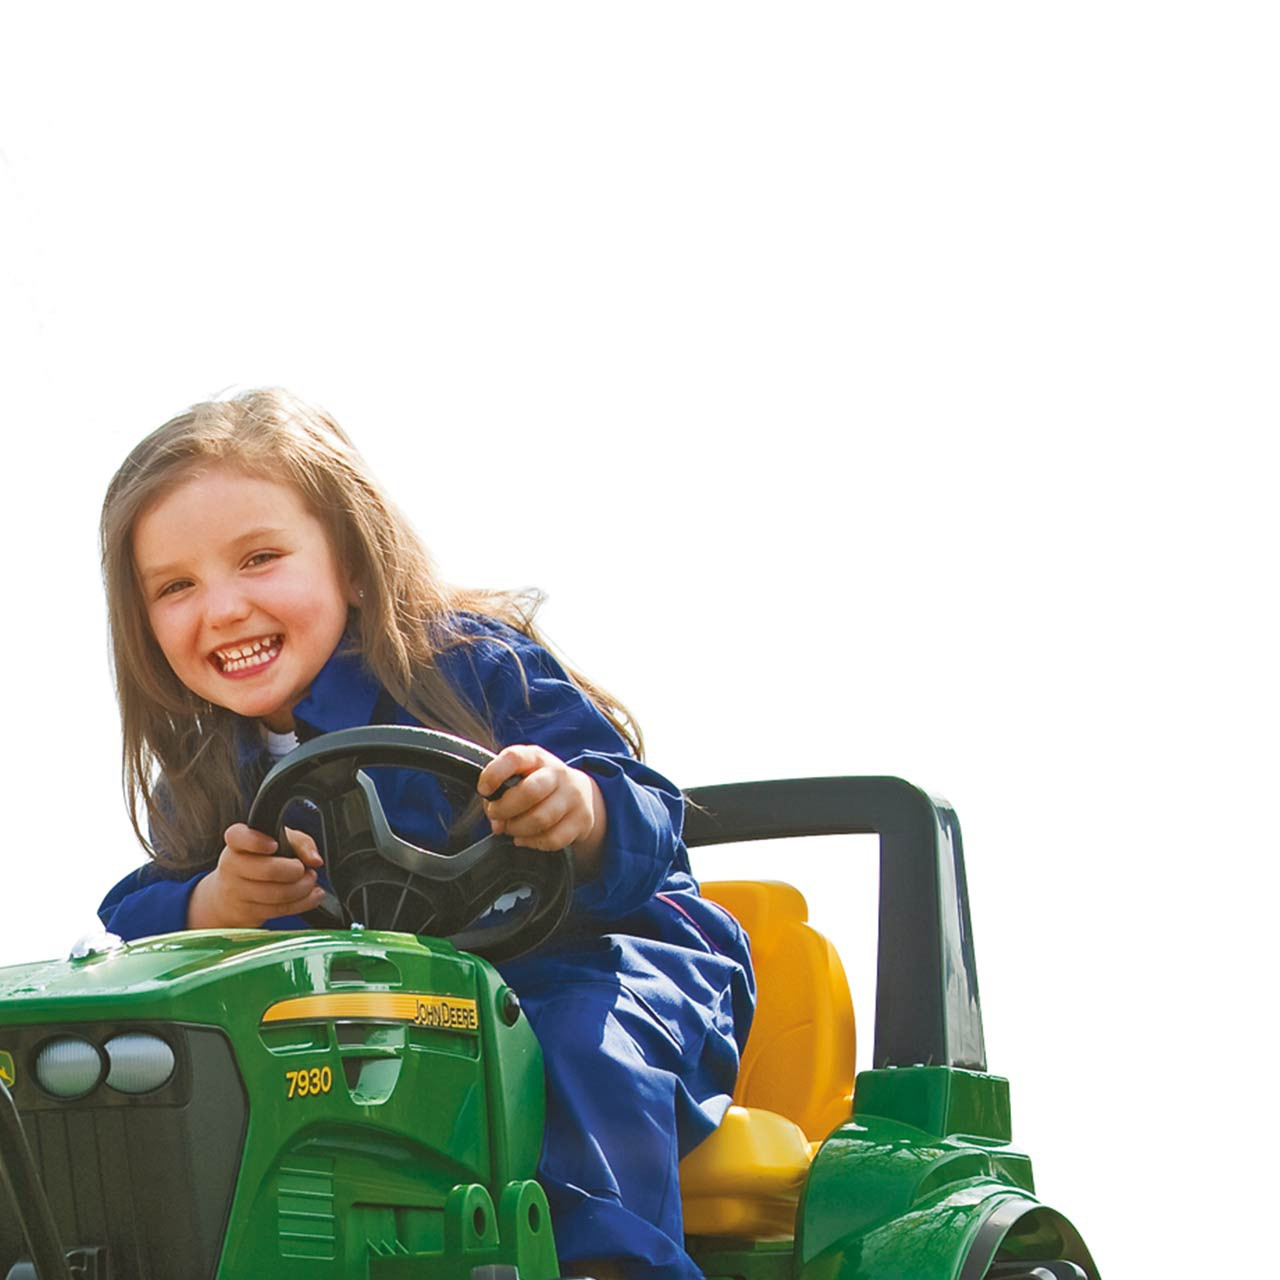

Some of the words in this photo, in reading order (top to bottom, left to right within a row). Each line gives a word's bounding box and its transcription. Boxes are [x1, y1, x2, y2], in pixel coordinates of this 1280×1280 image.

[414, 1000, 440, 1026] JOHN
[441, 1002, 475, 1028] DEERE
[285, 1066, 332, 1099] 7930
